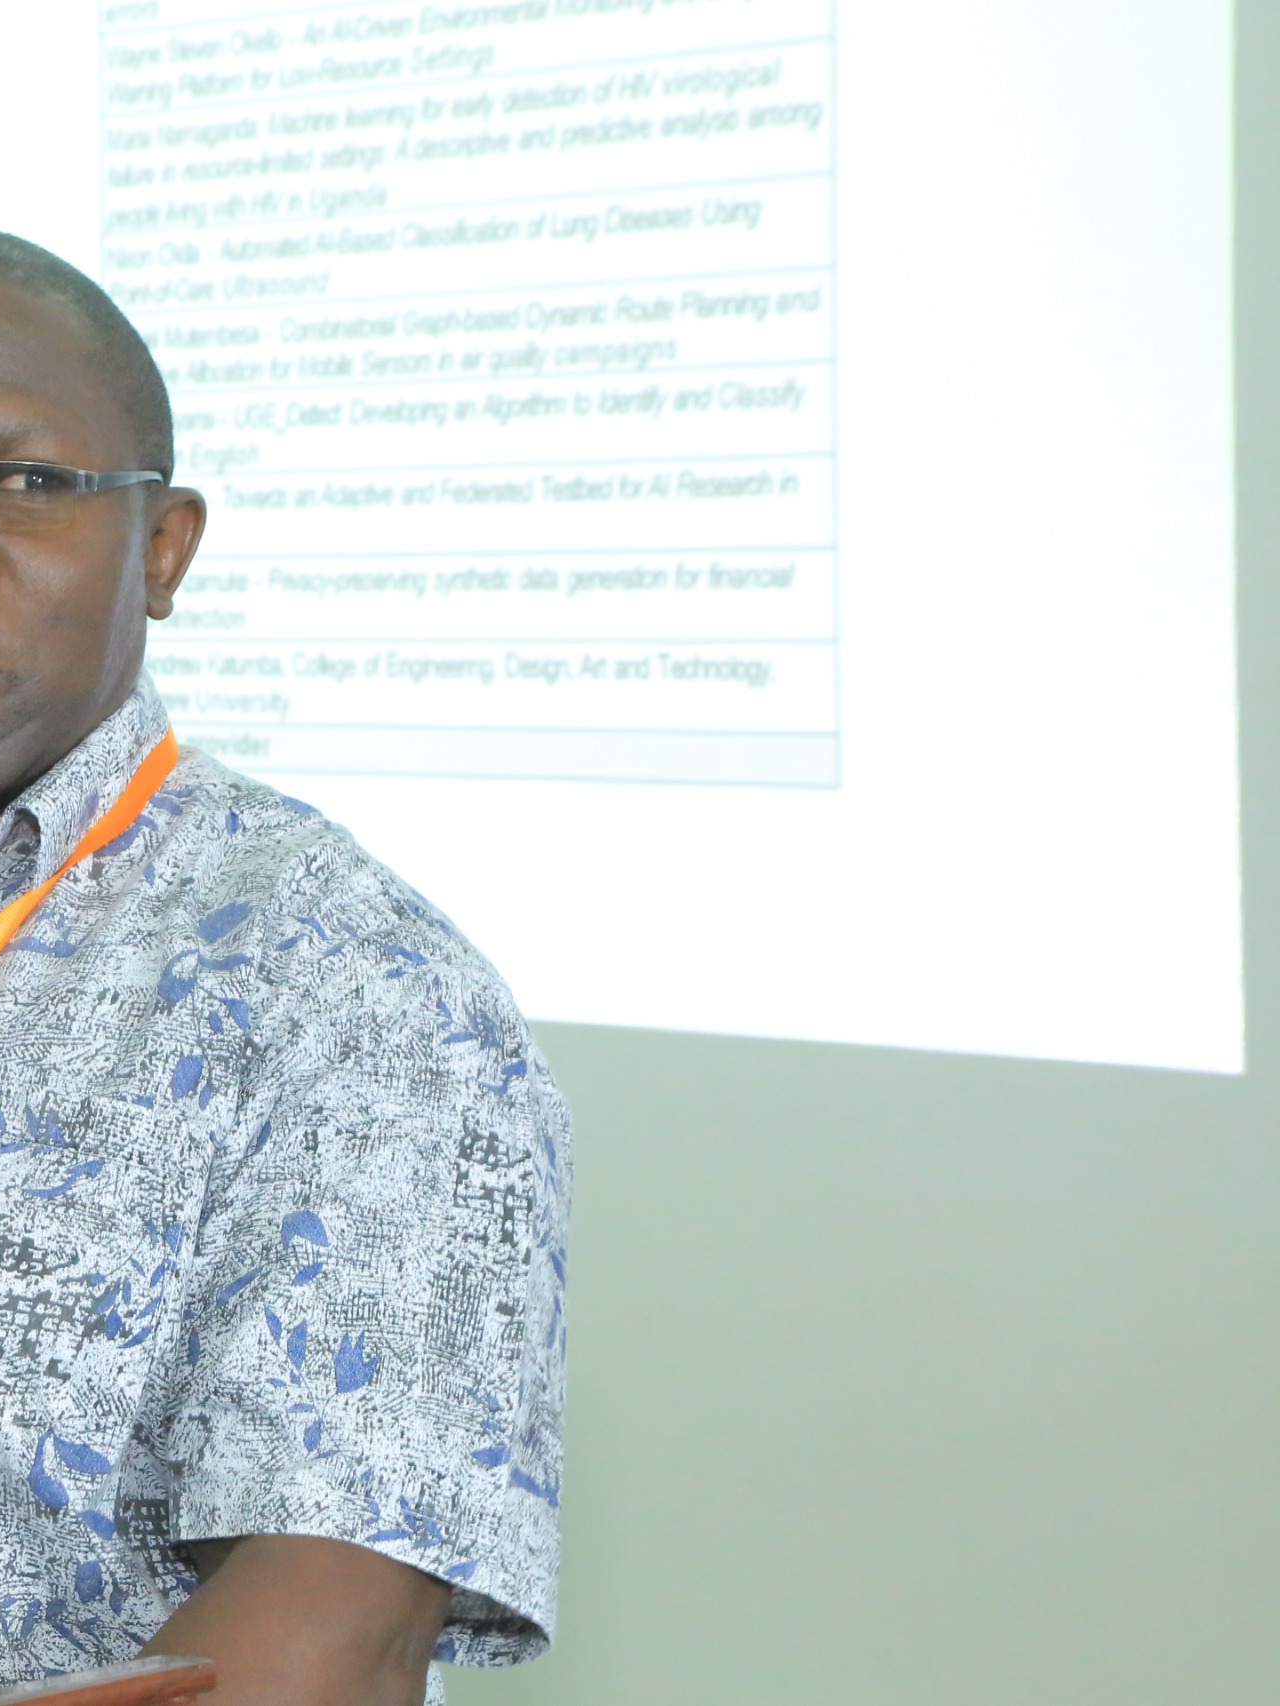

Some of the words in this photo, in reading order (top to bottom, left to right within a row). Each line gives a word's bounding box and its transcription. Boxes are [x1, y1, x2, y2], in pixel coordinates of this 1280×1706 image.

[178, 73, 245, 98] Platform
[251, 66, 275, 90] for
[412, 44, 496, 75] Settings
[267, 110, 338, 136] Machine
[345, 102, 418, 130] learning
[423, 96, 446, 121] for
[452, 90, 494, 120] early
[502, 80, 587, 114] detection
[593, 73, 617, 104] of
[619, 70, 658, 100] HIV
[663, 56, 783, 99] virological
[161, 164, 176, 183] in
[183, 147, 313, 182] resource-limited
[414, 131, 511, 160] descriptive
[519, 123, 555, 152] and
[560, 114, 654, 151] predictive
[660, 107, 739, 142] analysis
[747, 101, 824, 132] among
[213, 193, 246, 218] with
[288, 190, 303, 211] in
[310, 185, 388, 217] Uganda
[219, 235, 311, 262] Automated
[401, 217, 520, 250] Classification
[526, 211, 548, 240] of
[551, 209, 599, 244] Lung
[604, 202, 695, 234] Diseases
[701, 196, 763, 230] Using
[222, 269, 331, 301] Ultrasound
[279, 314, 397, 343] Combinatorial
[525, 301, 609, 335] Dynamic
[615, 296, 674, 326] Route
[680, 290, 770, 322] Planning
[775, 283, 823, 312] and
[184, 360, 264, 386] Allocation
[270, 355, 293, 381] for
[298, 351, 354, 378] Mobile
[361, 349, 431, 376] Sensors
[437, 348, 454, 370] in
[460, 347, 481, 371] air
[488, 341, 546, 377] quality
[552, 338, 678, 372] campaigns
[349, 397, 448, 428] Developing
[454, 402, 476, 422] an
[482, 392, 568, 427] Algorithm
[574, 389, 592, 416] to
[598, 384, 668, 420] Identify
[672, 383, 713, 412] and
[719, 377, 808, 414] Classify
[190, 443, 261, 475] English
[223, 484, 288, 508] Towards
[294, 489, 316, 508] an
[320, 482, 394, 512] Adaptive
[401, 483, 436, 507] and
[441, 477, 534, 505] Federated
[541, 474, 613, 502] Testbed
[619, 474, 645, 498] for
[647, 472, 673, 498] AI
[676, 469, 774, 498] Research
[779, 468, 800, 496] in
[269, 566, 427, 599] Privacy-preserving
[434, 564, 514, 598] synthetic
[519, 565, 560, 592] data
[566, 563, 668, 599] generation
[674, 561, 702, 590] for
[707, 561, 797, 591] financial
[291, 651, 358, 684] College
[364, 652, 382, 677] of
[579, 654, 610, 680] Art
[614, 655, 651, 681] and
[195, 689, 291, 721] University
